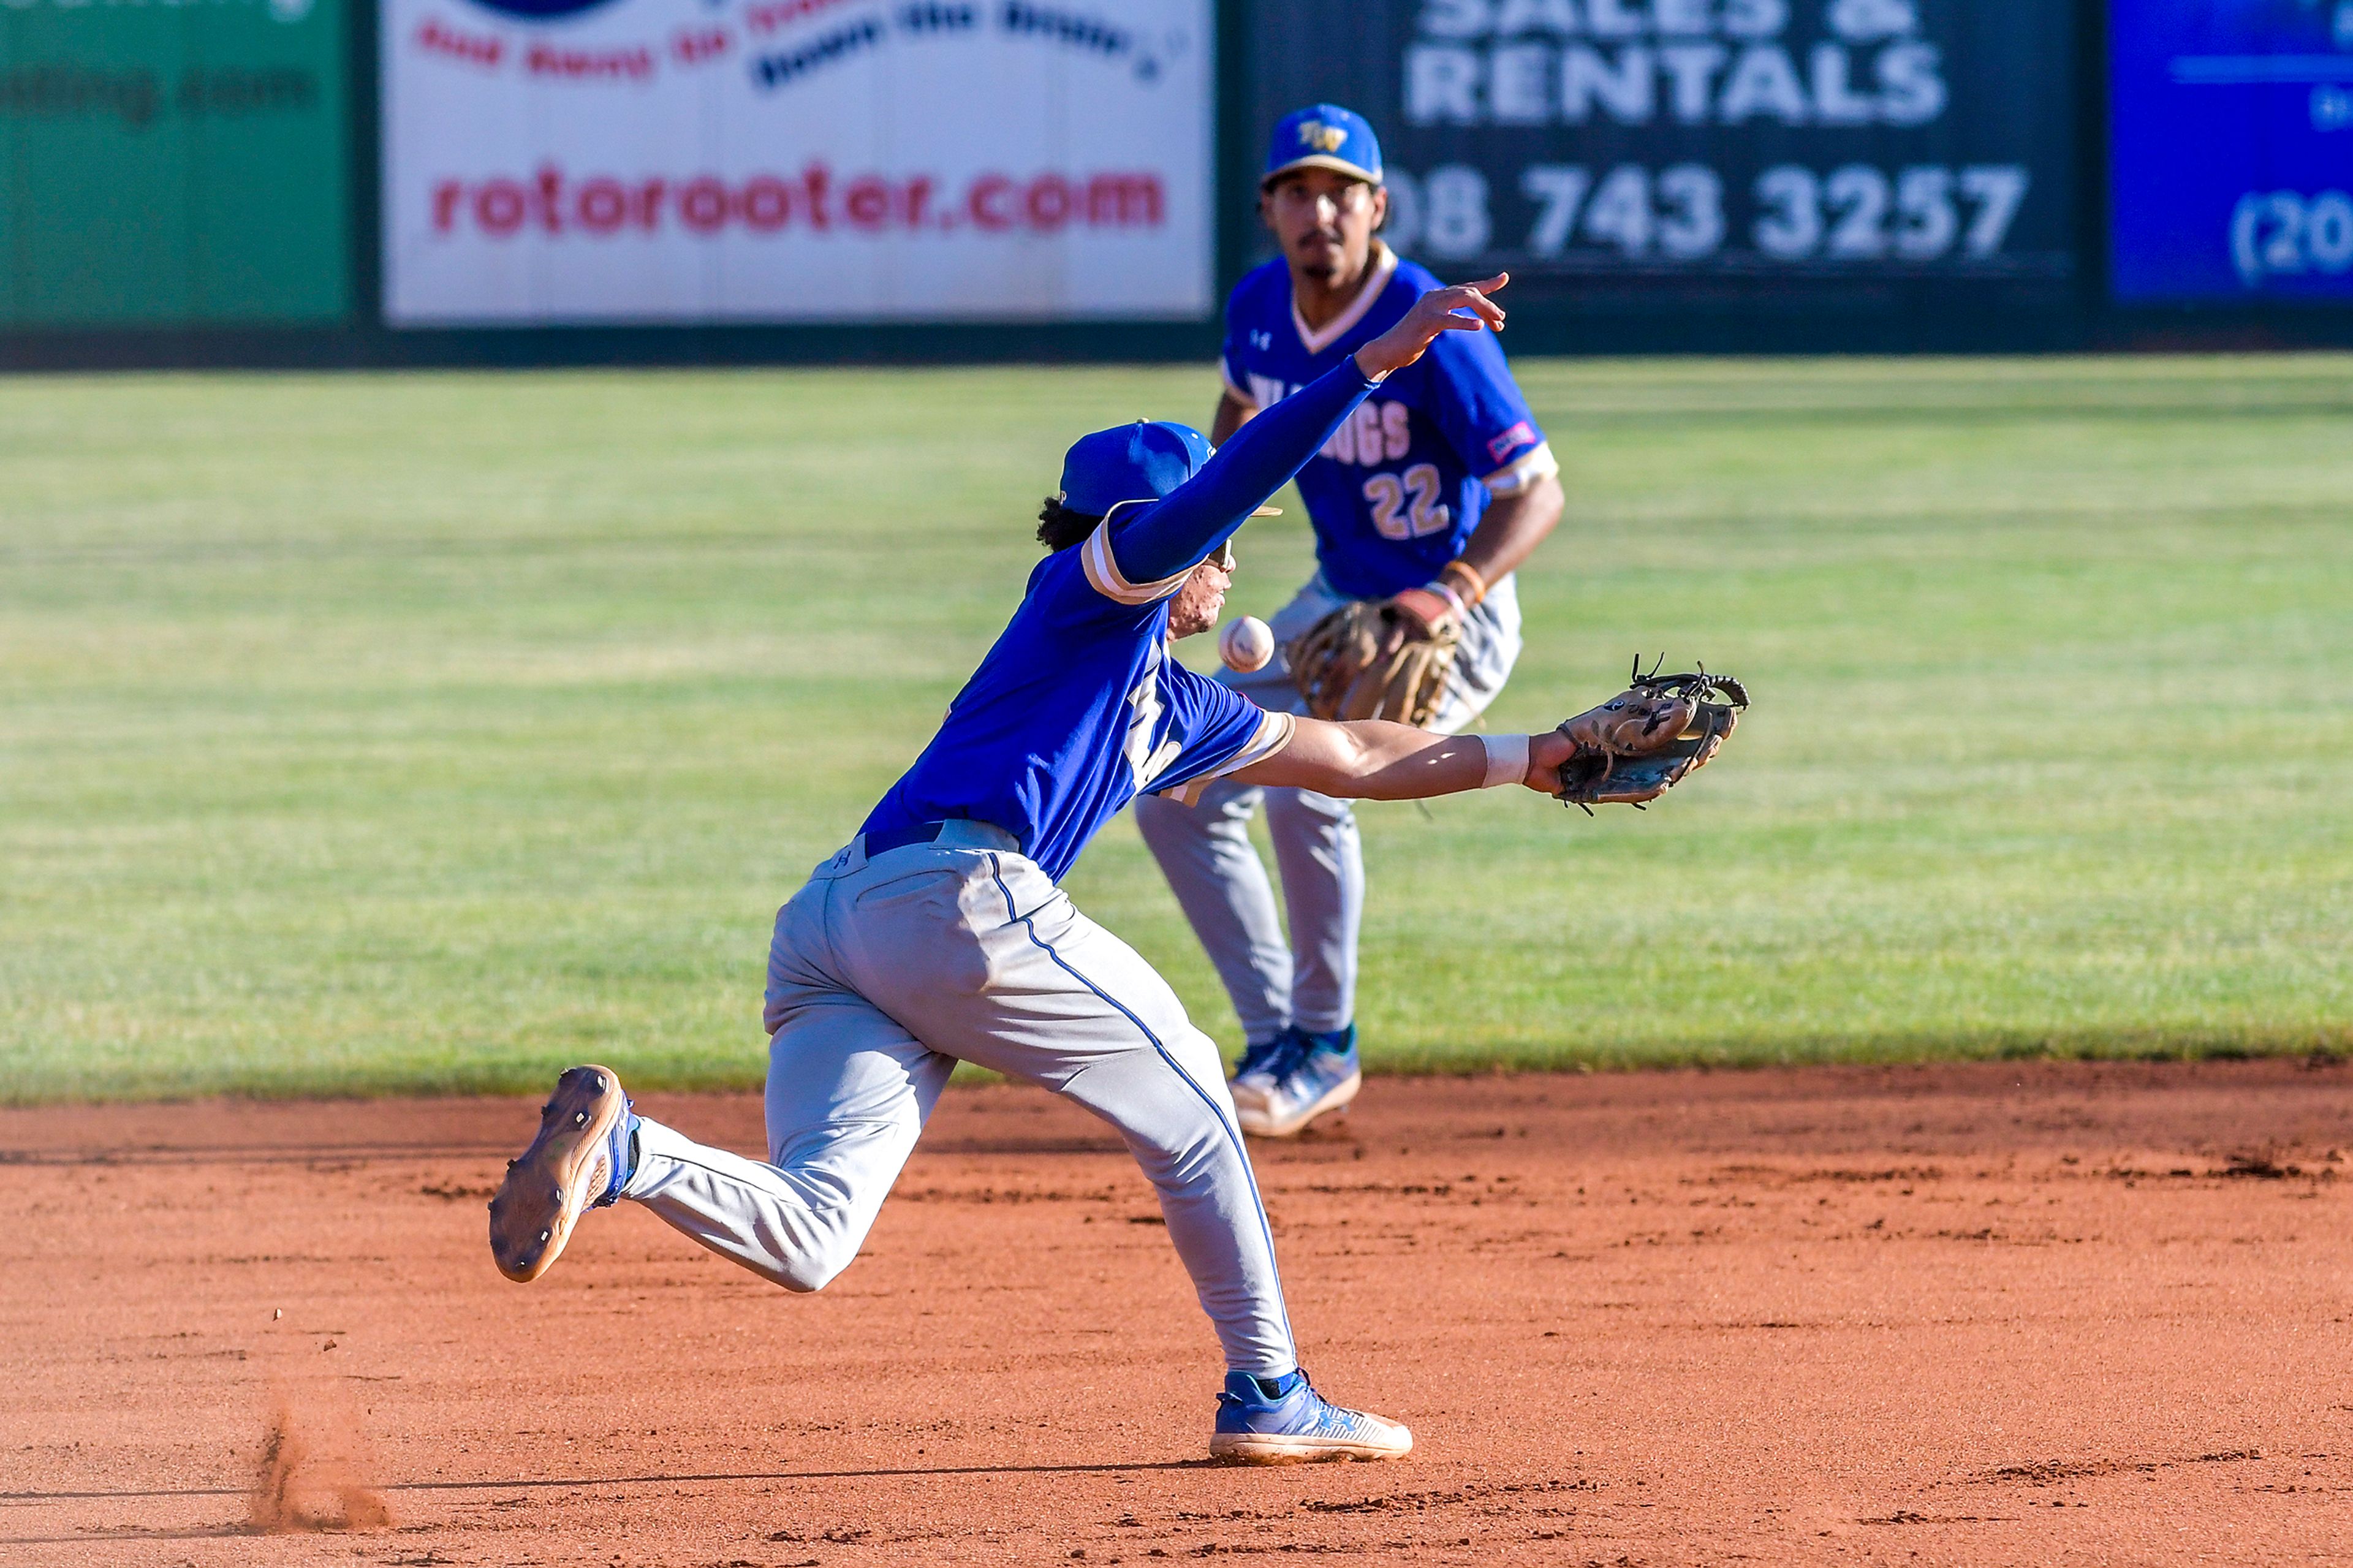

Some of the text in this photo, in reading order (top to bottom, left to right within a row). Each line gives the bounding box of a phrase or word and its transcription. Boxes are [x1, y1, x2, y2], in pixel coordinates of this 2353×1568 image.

[1403, 43, 1950, 126] RENTALS
[430, 158, 1167, 239] rotorooter.com
[1517, 161, 1727, 260] 743
[1751, 162, 2029, 261] 3257
[1363, 462, 1451, 542] 22
